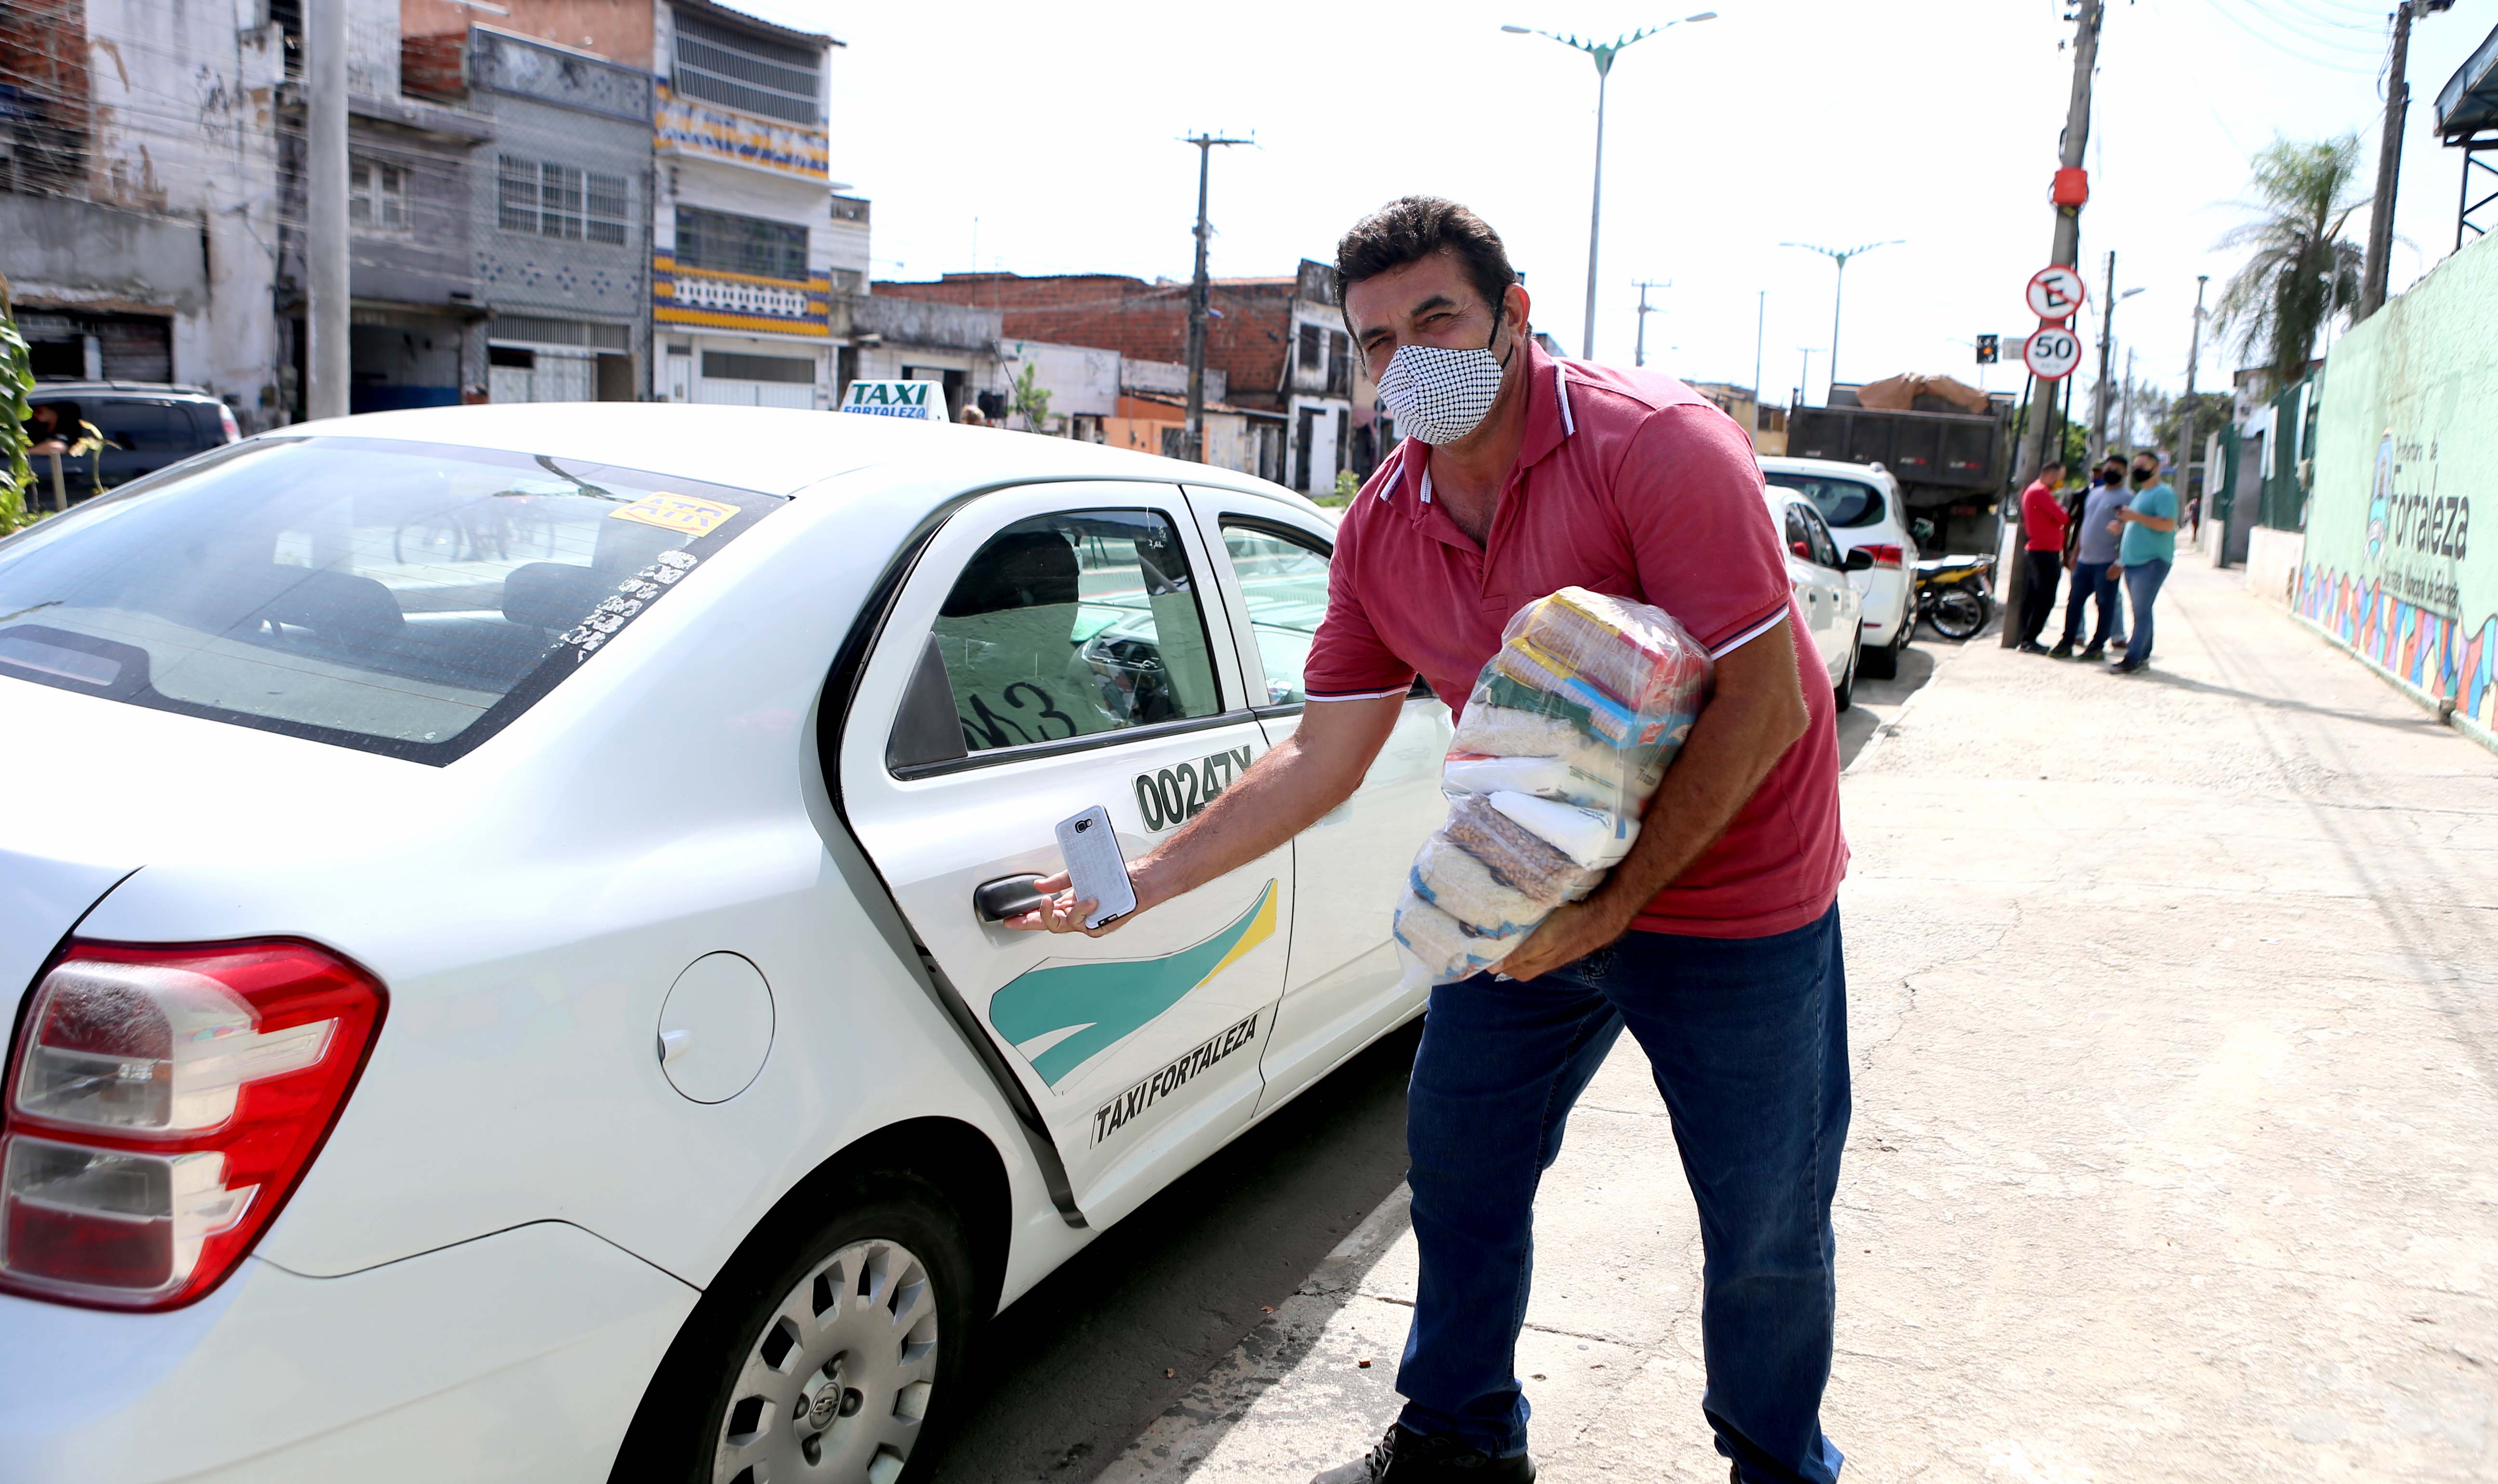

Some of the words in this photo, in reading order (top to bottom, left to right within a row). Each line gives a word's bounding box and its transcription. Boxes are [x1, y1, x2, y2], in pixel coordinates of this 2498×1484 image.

[2035, 335, 2072, 359] 50
[852, 384, 928, 405] TAXI
[844, 406, 926, 419] FORTALEZA
[2386, 463, 2468, 562] Fortaleza
[1147, 1013, 1258, 1108] FORTALEZA
